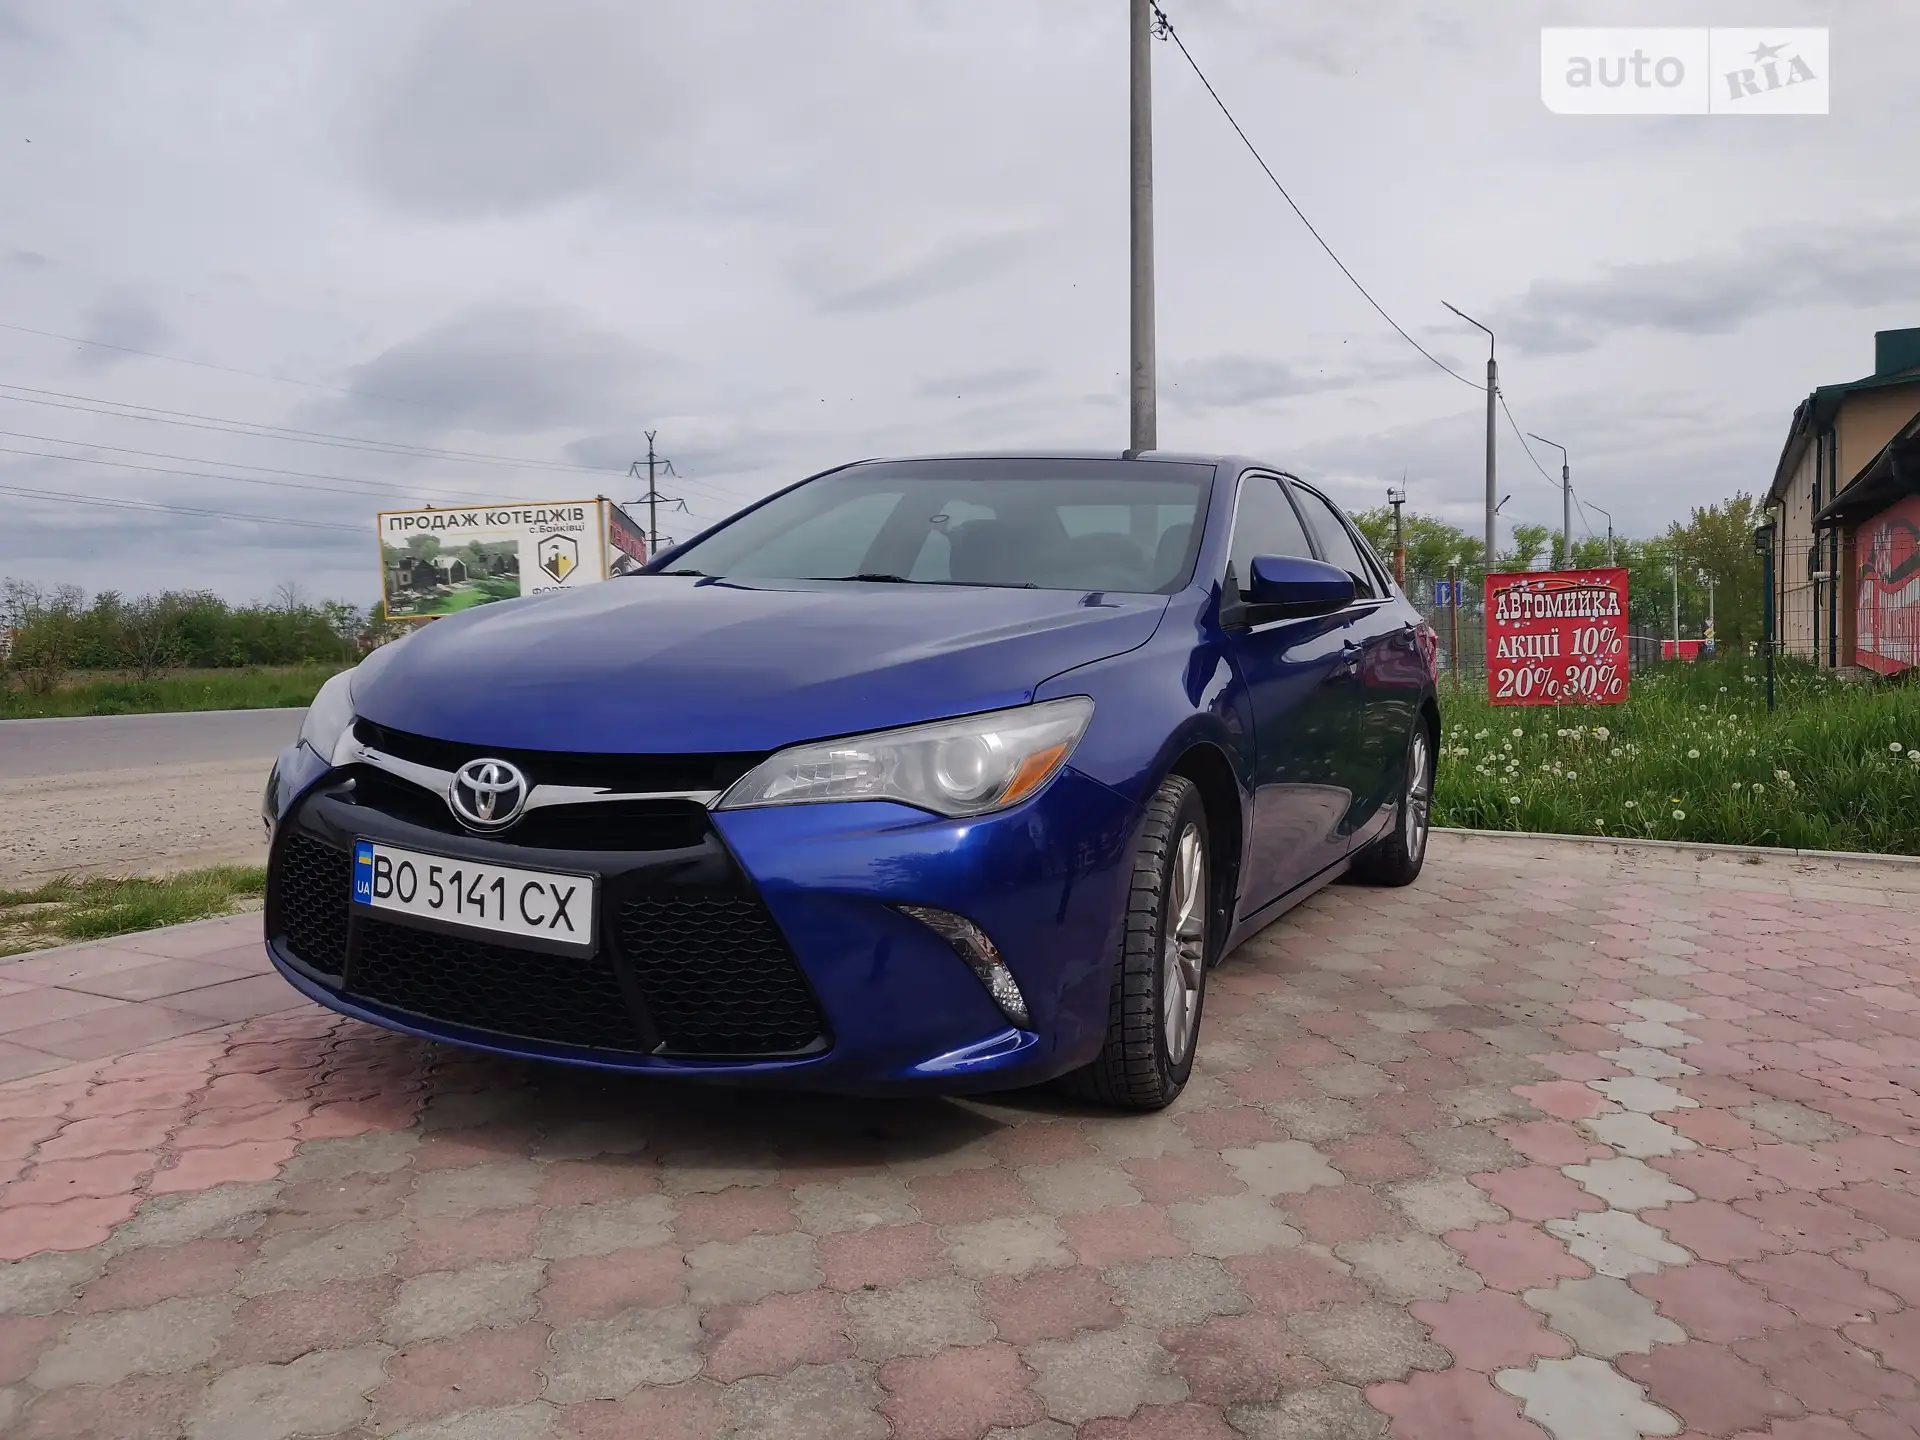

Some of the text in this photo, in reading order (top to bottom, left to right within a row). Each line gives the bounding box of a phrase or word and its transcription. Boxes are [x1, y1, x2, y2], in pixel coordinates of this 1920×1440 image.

[389, 507, 585, 531] ПРОДАЖ КОТЕДЖІВ
[1495, 591, 1621, 620] АВТОМИЙКА
[1495, 626, 1622, 662] АКЦІЇ 10%
[1496, 664, 1623, 698] 20% 30%
[356, 880, 370, 896] UA
[373, 854, 576, 932] BO 5141 CX
